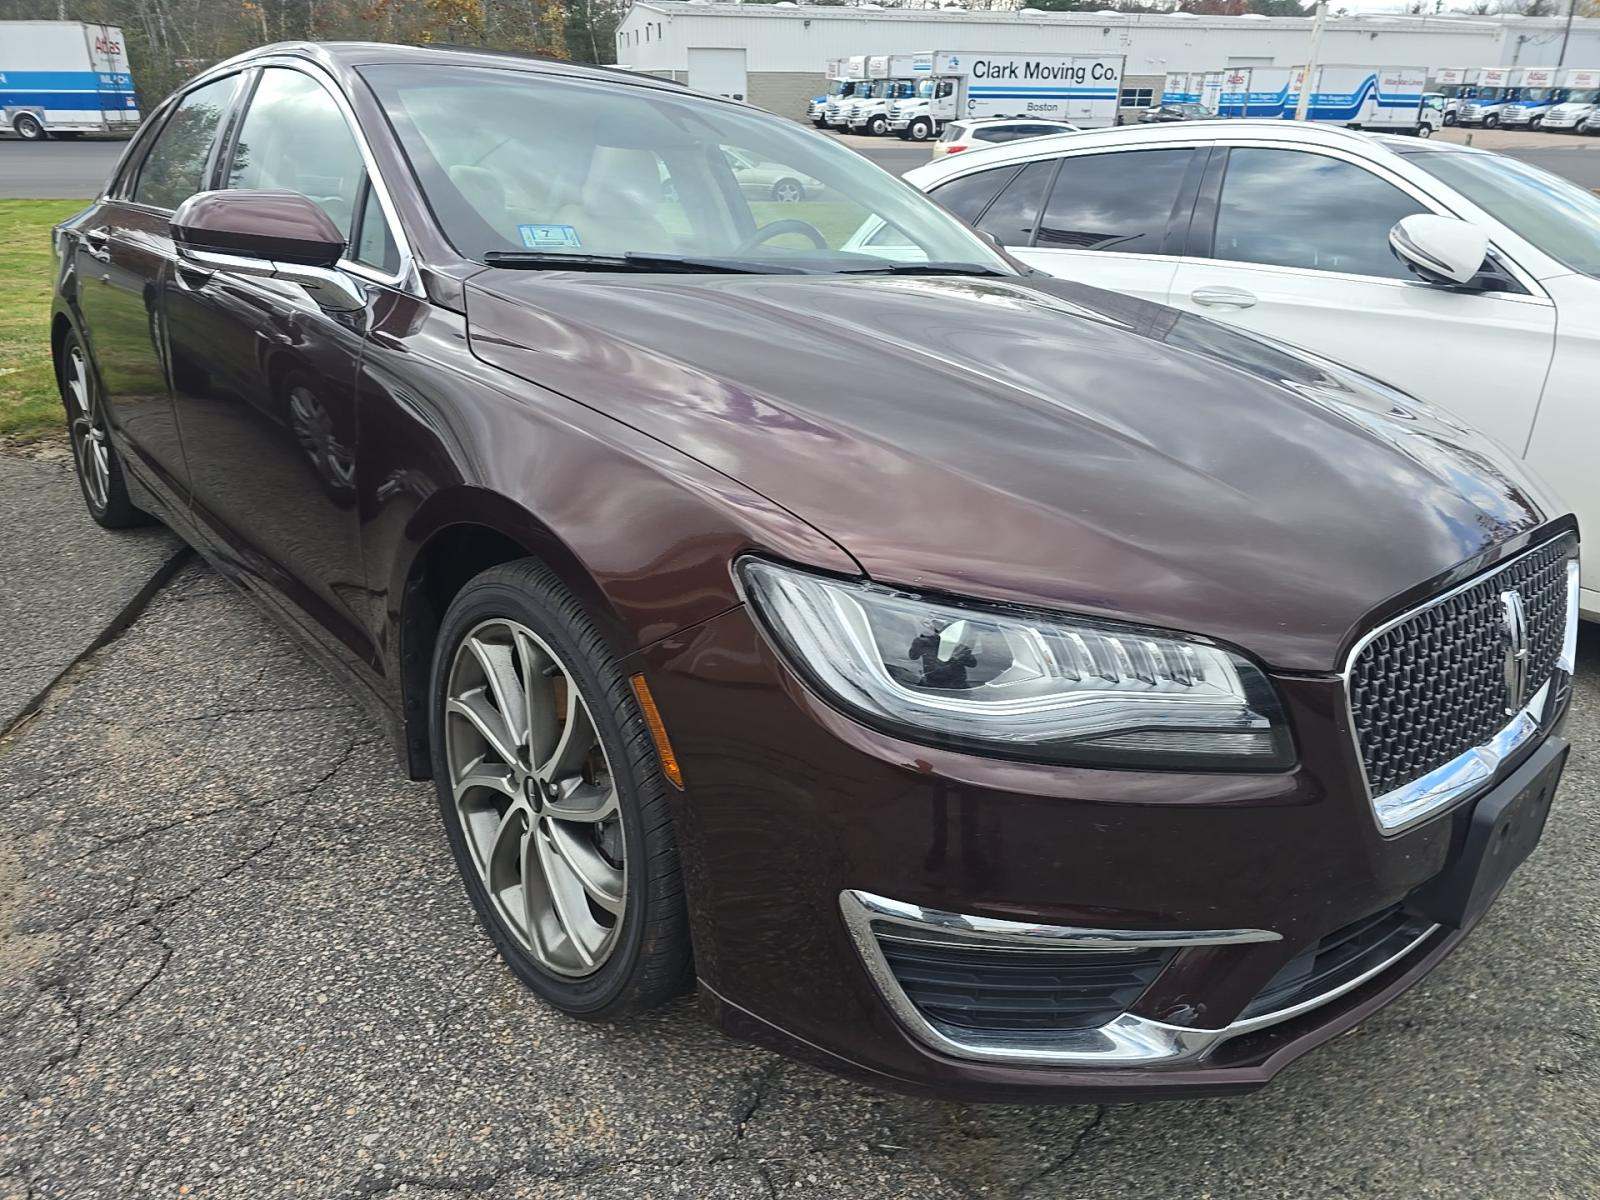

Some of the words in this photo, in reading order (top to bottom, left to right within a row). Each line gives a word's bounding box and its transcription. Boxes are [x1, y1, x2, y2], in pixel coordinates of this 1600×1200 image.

[973, 60, 1018, 79] Clark
[1024, 62, 1085, 84] Moving
[1091, 63, 1118, 81] Co.
[1026, 102, 1058, 112] Boston
[541, 229, 550, 237] 7
